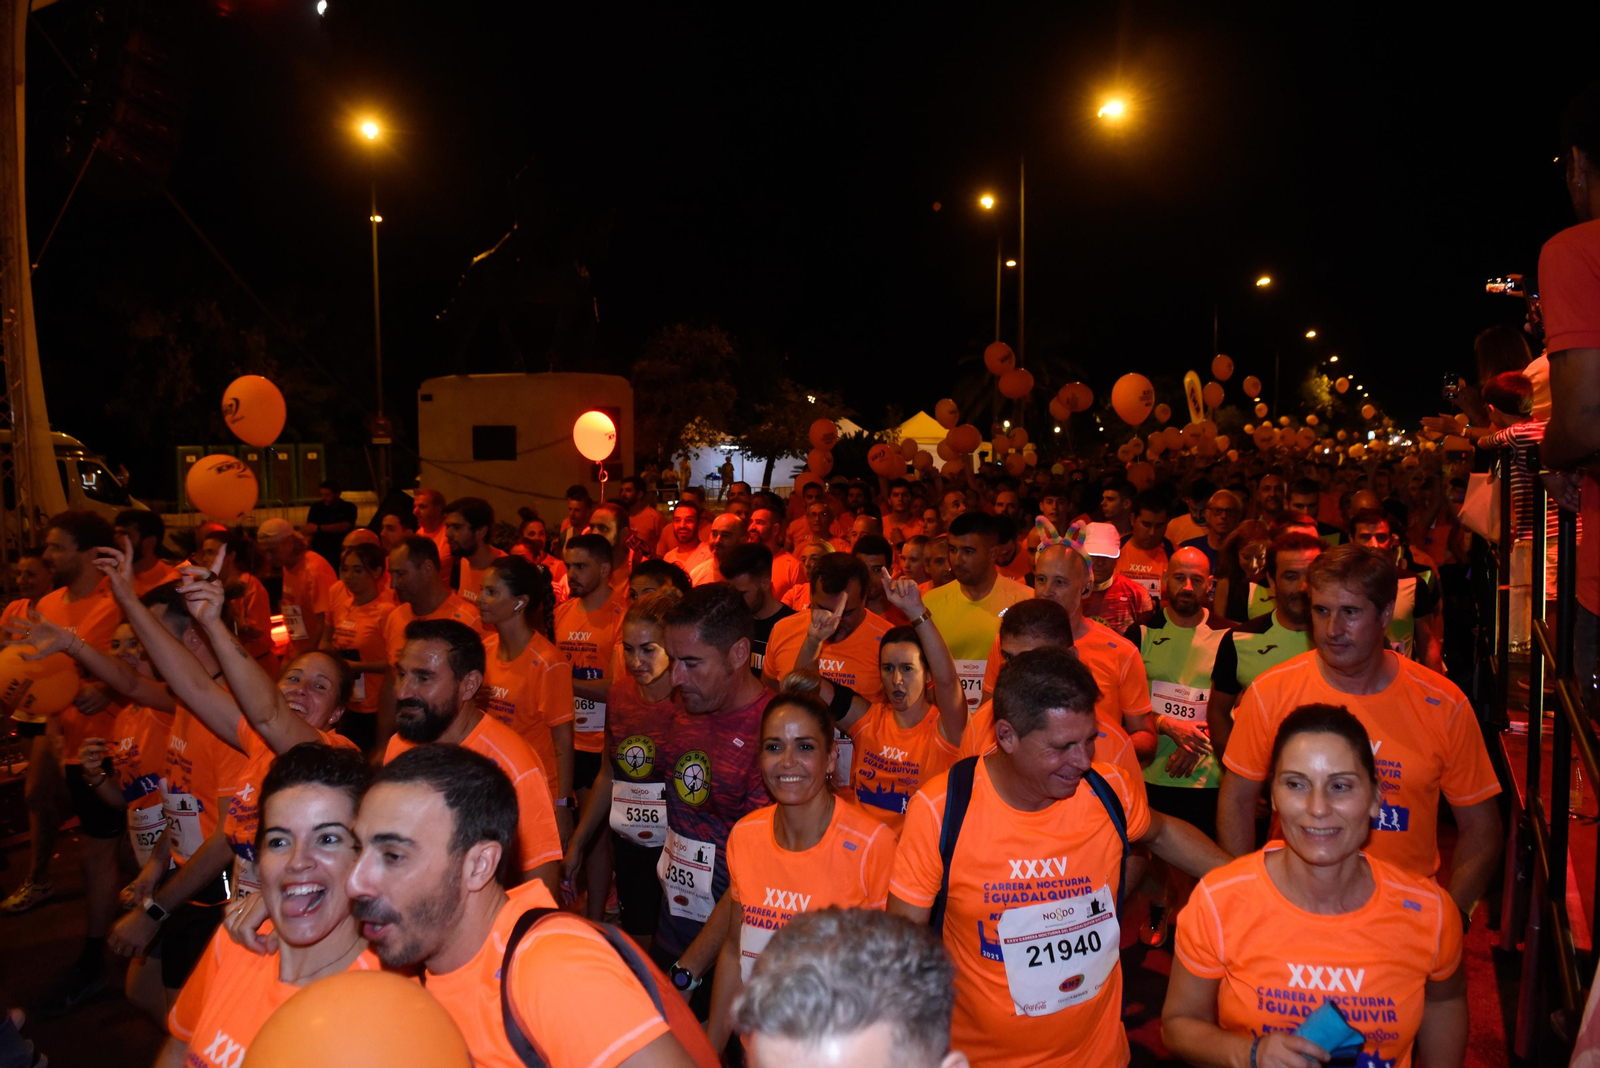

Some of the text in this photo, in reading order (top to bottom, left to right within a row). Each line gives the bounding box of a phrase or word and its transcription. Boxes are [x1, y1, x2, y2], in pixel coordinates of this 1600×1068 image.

[1129, 563, 1153, 573] XXXV
[567, 631, 592, 641] XXXV
[819, 658, 845, 671] XXV
[961, 679, 981, 690] 971
[574, 699, 595, 710] 068
[1164, 702, 1195, 718] 9383
[863, 756, 919, 775] GUADALQUIVIR
[626, 807, 659, 823] 5356
[167, 816, 182, 831] 21
[1008, 856, 1068, 880] XXXV
[983, 876, 1091, 892] CARRERA NOCTURNA
[762, 887, 811, 913] XXXV
[991, 885, 1093, 904] GUADALQUIVIR
[741, 904, 777, 919] CARRERA
[1025, 930, 1102, 968] 21940
[1286, 962, 1365, 993] XXXV
[1256, 986, 1396, 1007] CARRERA NOCTURNA
[1265, 1000, 1398, 1023] GUADQUIVIR
